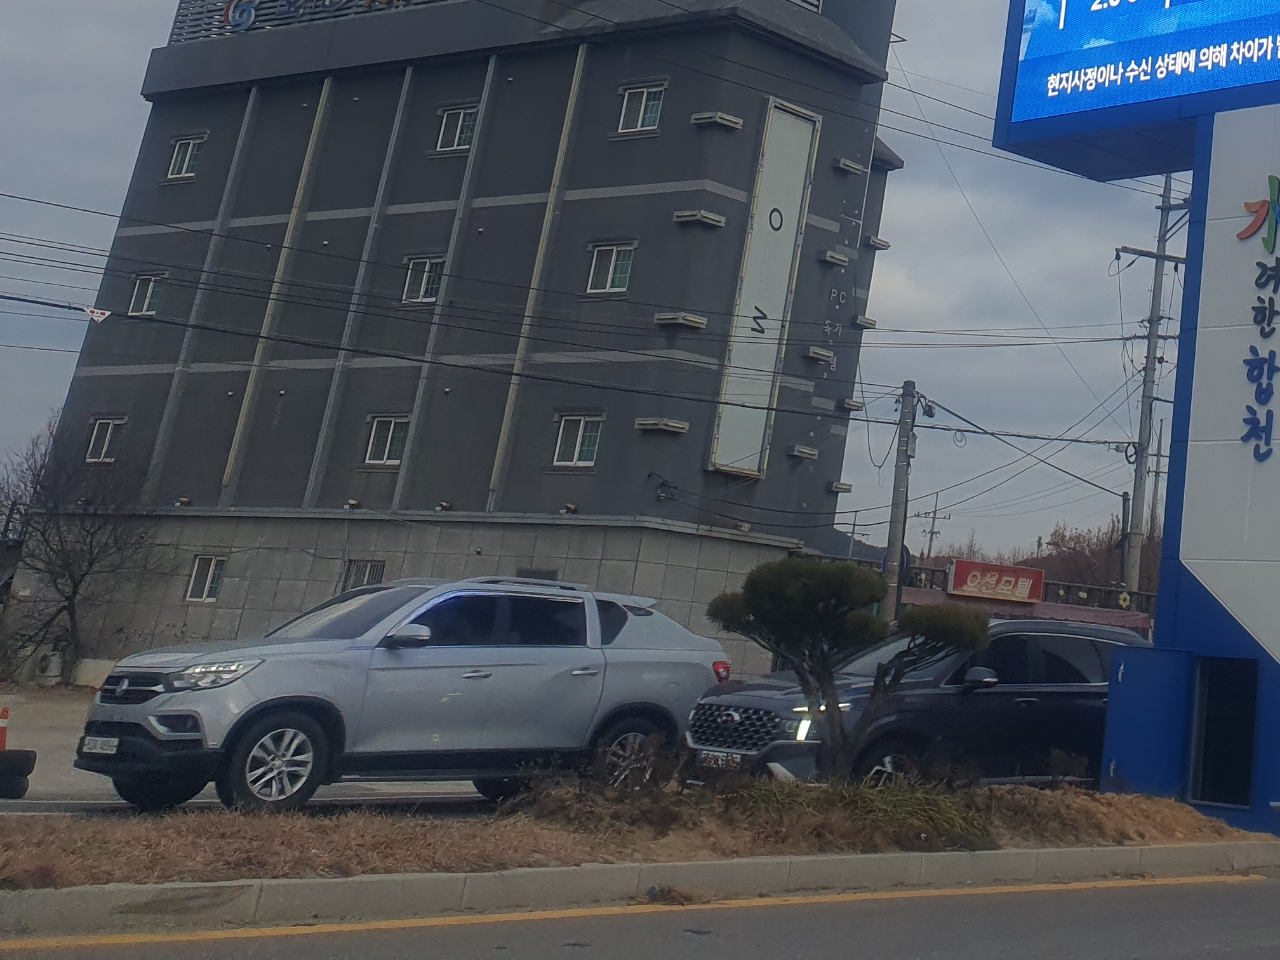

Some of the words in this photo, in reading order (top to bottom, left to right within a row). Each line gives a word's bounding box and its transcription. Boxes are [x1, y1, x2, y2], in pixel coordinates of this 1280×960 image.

[1047, 61, 1124, 97] 현지사정이나
[1125, 56, 1152, 83] 수신
[1155, 49, 1196, 79] 상태에
[1198, 43, 1227, 71] 의해
[1230, 35, 1273, 64] 차이가
[830, 288, 847, 304] PC
[1241, 345, 1280, 463] 합천
[962, 571, 1033, 597] 오션모텔
